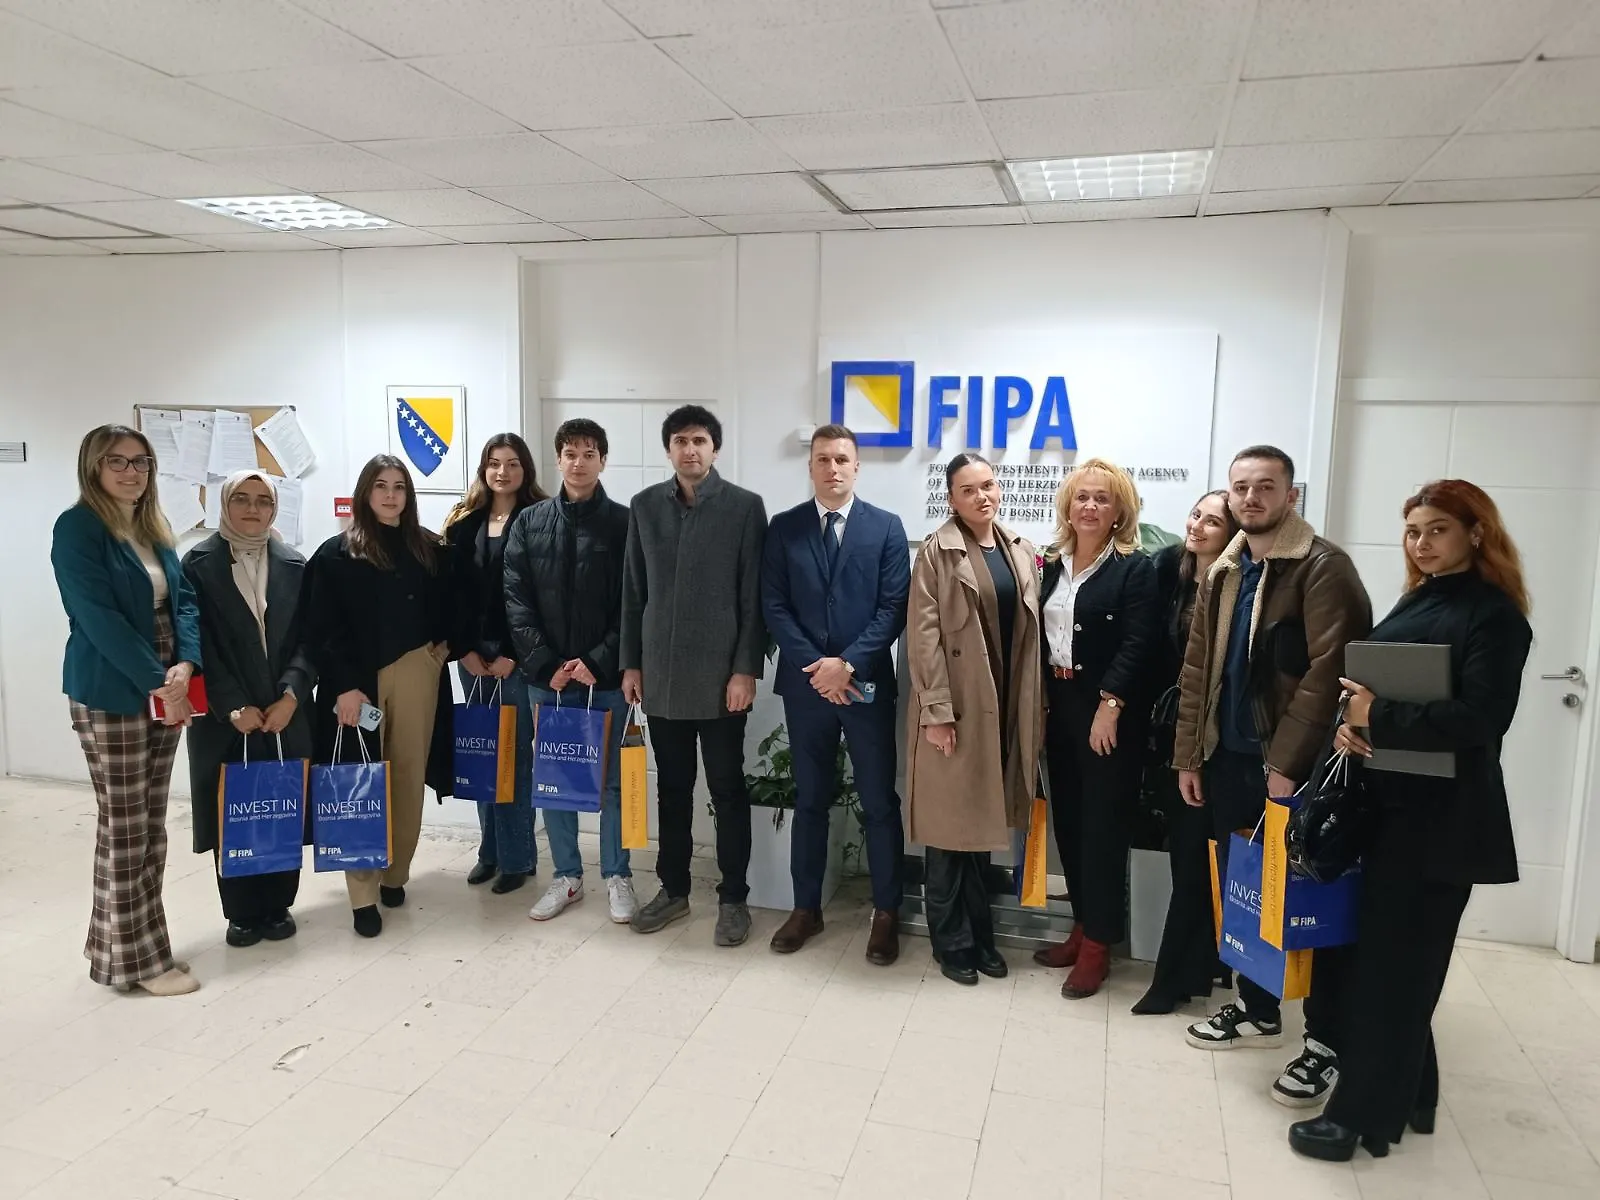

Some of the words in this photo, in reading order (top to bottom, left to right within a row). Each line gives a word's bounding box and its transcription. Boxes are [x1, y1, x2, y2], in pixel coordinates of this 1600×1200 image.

[928, 376, 1078, 450] FIPA
[992, 464, 1059, 474] VESTMENT
[1138, 467, 1189, 477] AGENCY
[928, 478, 943, 487] OF
[998, 479, 1015, 488] ND
[999, 507, 1007, 517] U
[1010, 508, 1045, 517] BOSNI
[455, 737, 486, 749] INVEST
[487, 739, 496, 750] IN
[540, 741, 583, 755] INVEST
[586, 745, 598, 758] IN
[545, 785, 558, 793] FIPA
[229, 799, 279, 816] INVEST
[282, 798, 297, 811] IN
[317, 800, 363, 815] INVEST
[367, 799, 381, 811] IN
[237, 849, 253, 857] FIPA
[327, 847, 342, 855] FIPA
[1300, 916, 1316, 927] FIPA
